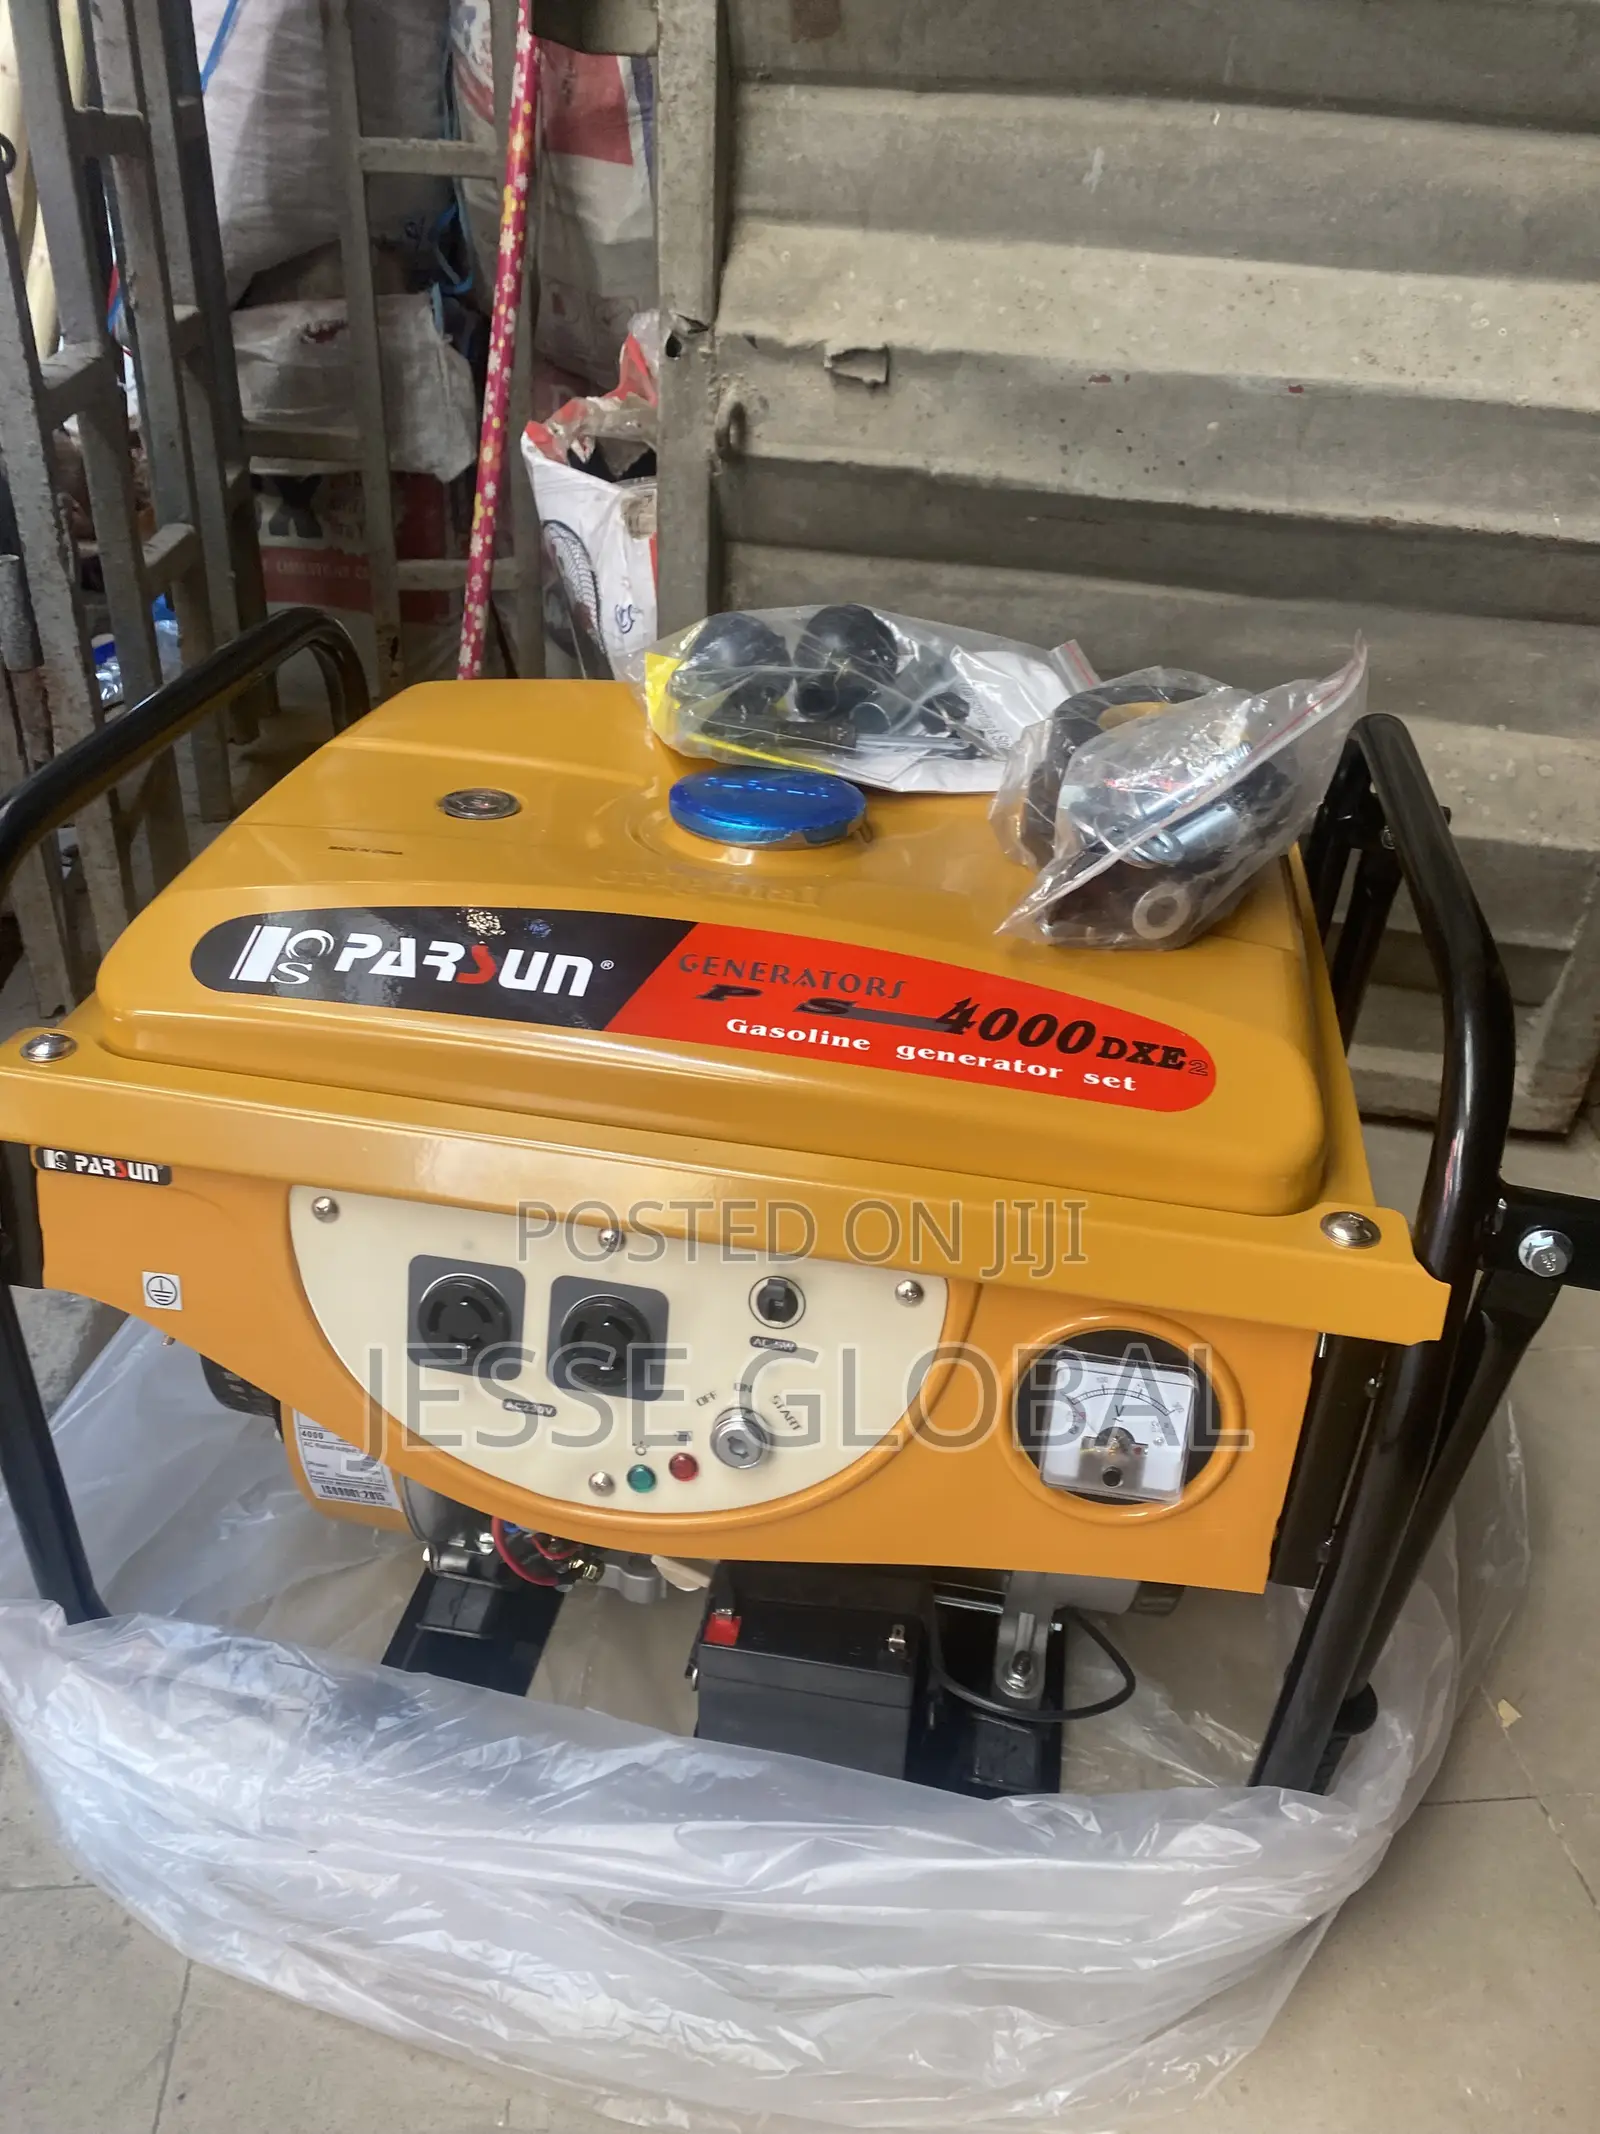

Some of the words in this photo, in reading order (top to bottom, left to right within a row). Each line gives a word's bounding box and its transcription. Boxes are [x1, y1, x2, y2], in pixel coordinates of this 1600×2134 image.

[678, 953, 908, 999] GENERATORS
[725, 1018, 871, 1052] Gasoline
[896, 1042, 1064, 1080] generator
[1082, 1071, 1138, 1092] set
[695, 1390, 717, 1407] OFF
[733, 1382, 753, 1393] ON
[770, 1394, 803, 1432] START
